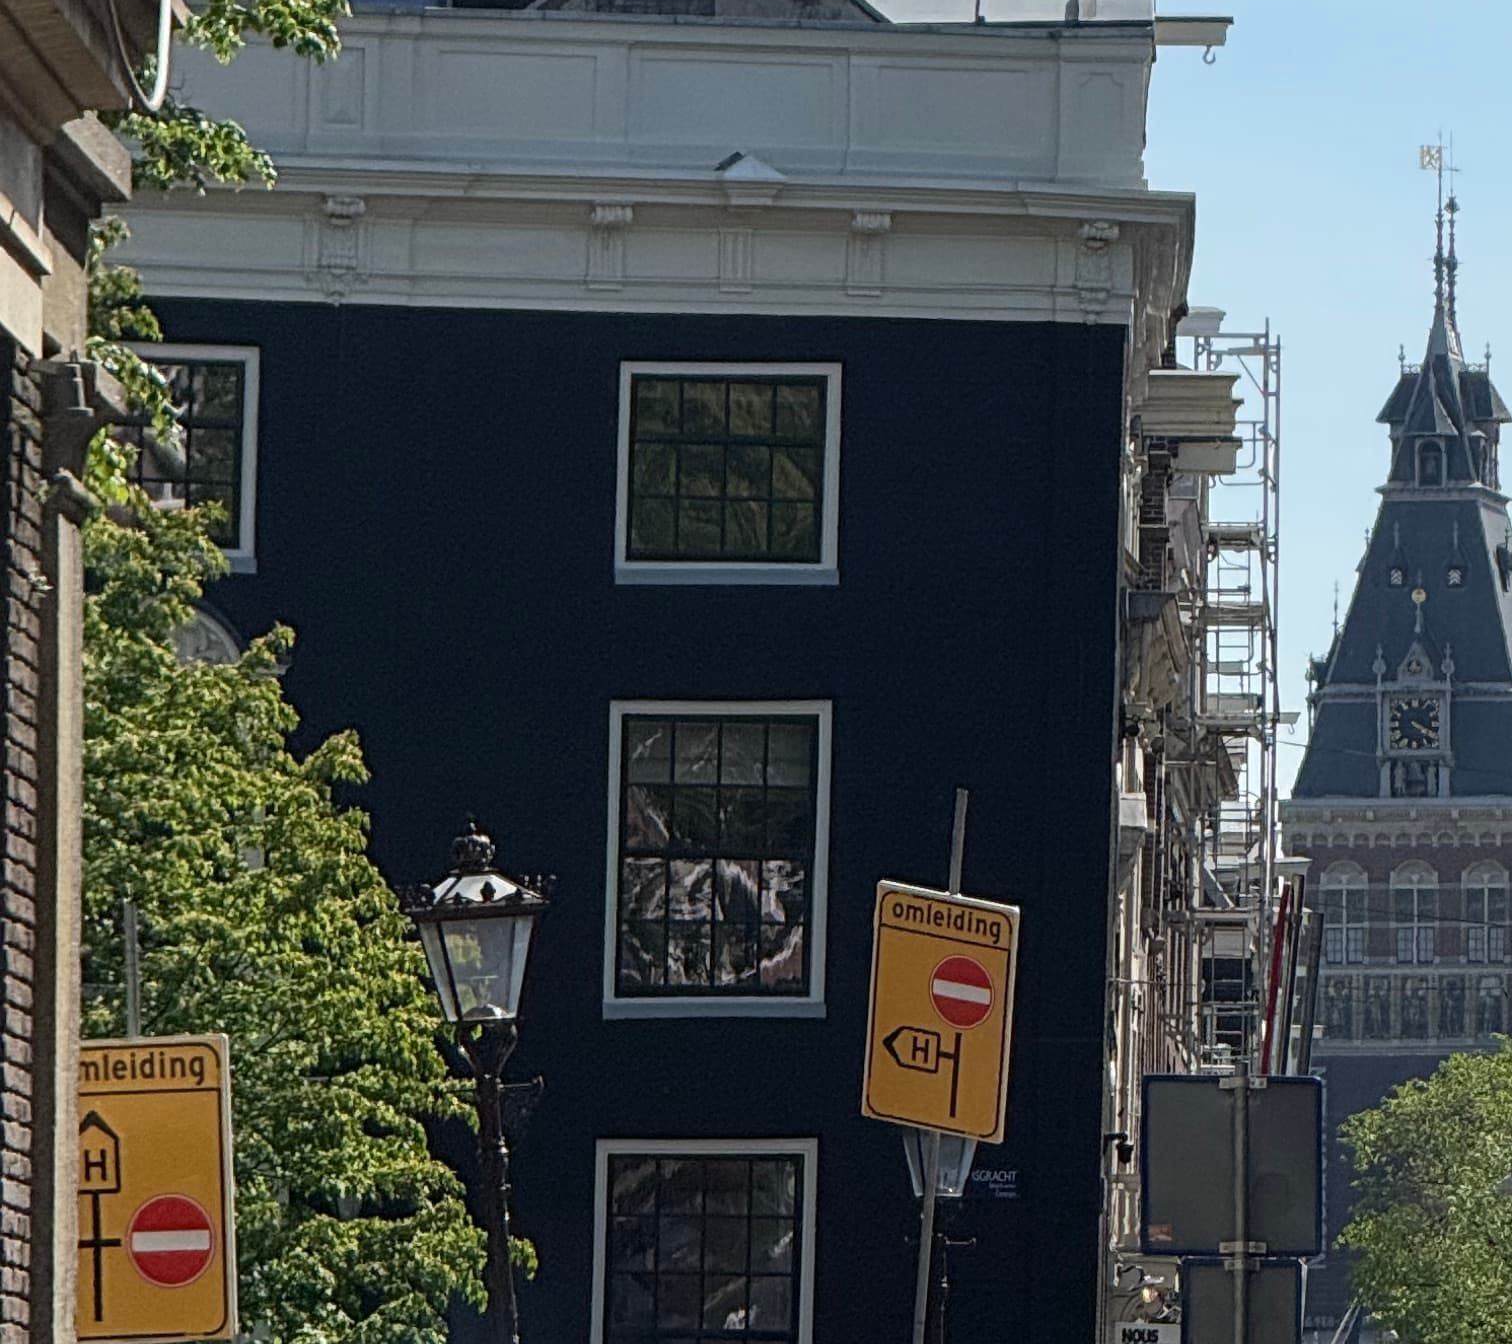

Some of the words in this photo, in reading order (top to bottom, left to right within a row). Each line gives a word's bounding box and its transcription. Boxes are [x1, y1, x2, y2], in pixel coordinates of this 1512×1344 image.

[892, 902, 1001, 944] omleiding
[912, 1036, 930, 1063] H
[79, 1051, 205, 1085] mleiding
[84, 1148, 107, 1182] H
[1122, 1327, 1159, 1343] NOUS
